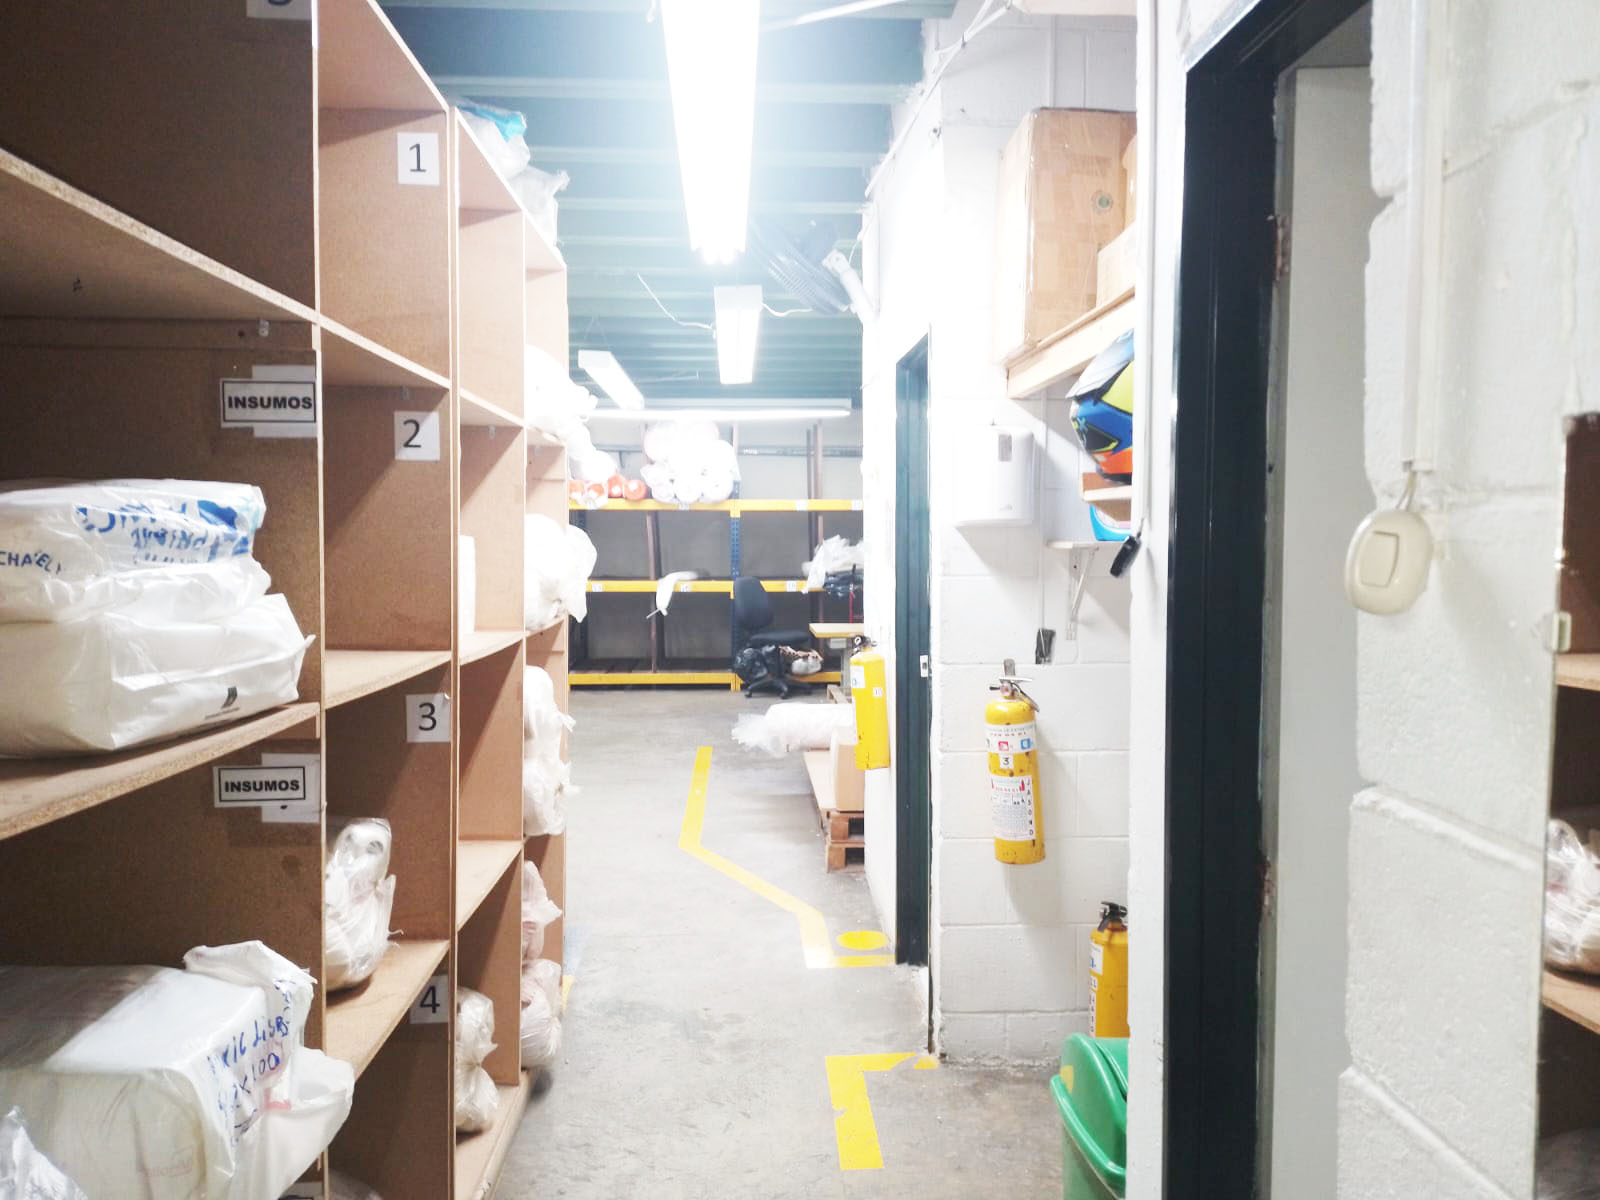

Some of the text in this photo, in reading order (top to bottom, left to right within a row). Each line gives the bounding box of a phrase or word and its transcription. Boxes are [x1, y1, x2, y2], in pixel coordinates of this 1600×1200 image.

[409, 143, 427, 173] 1
[227, 395, 313, 410] INSUMOS
[403, 418, 422, 449] 2
[418, 701, 437, 732] 3
[224, 779, 300, 793] INSUMOS
[419, 986, 441, 1014] 4
